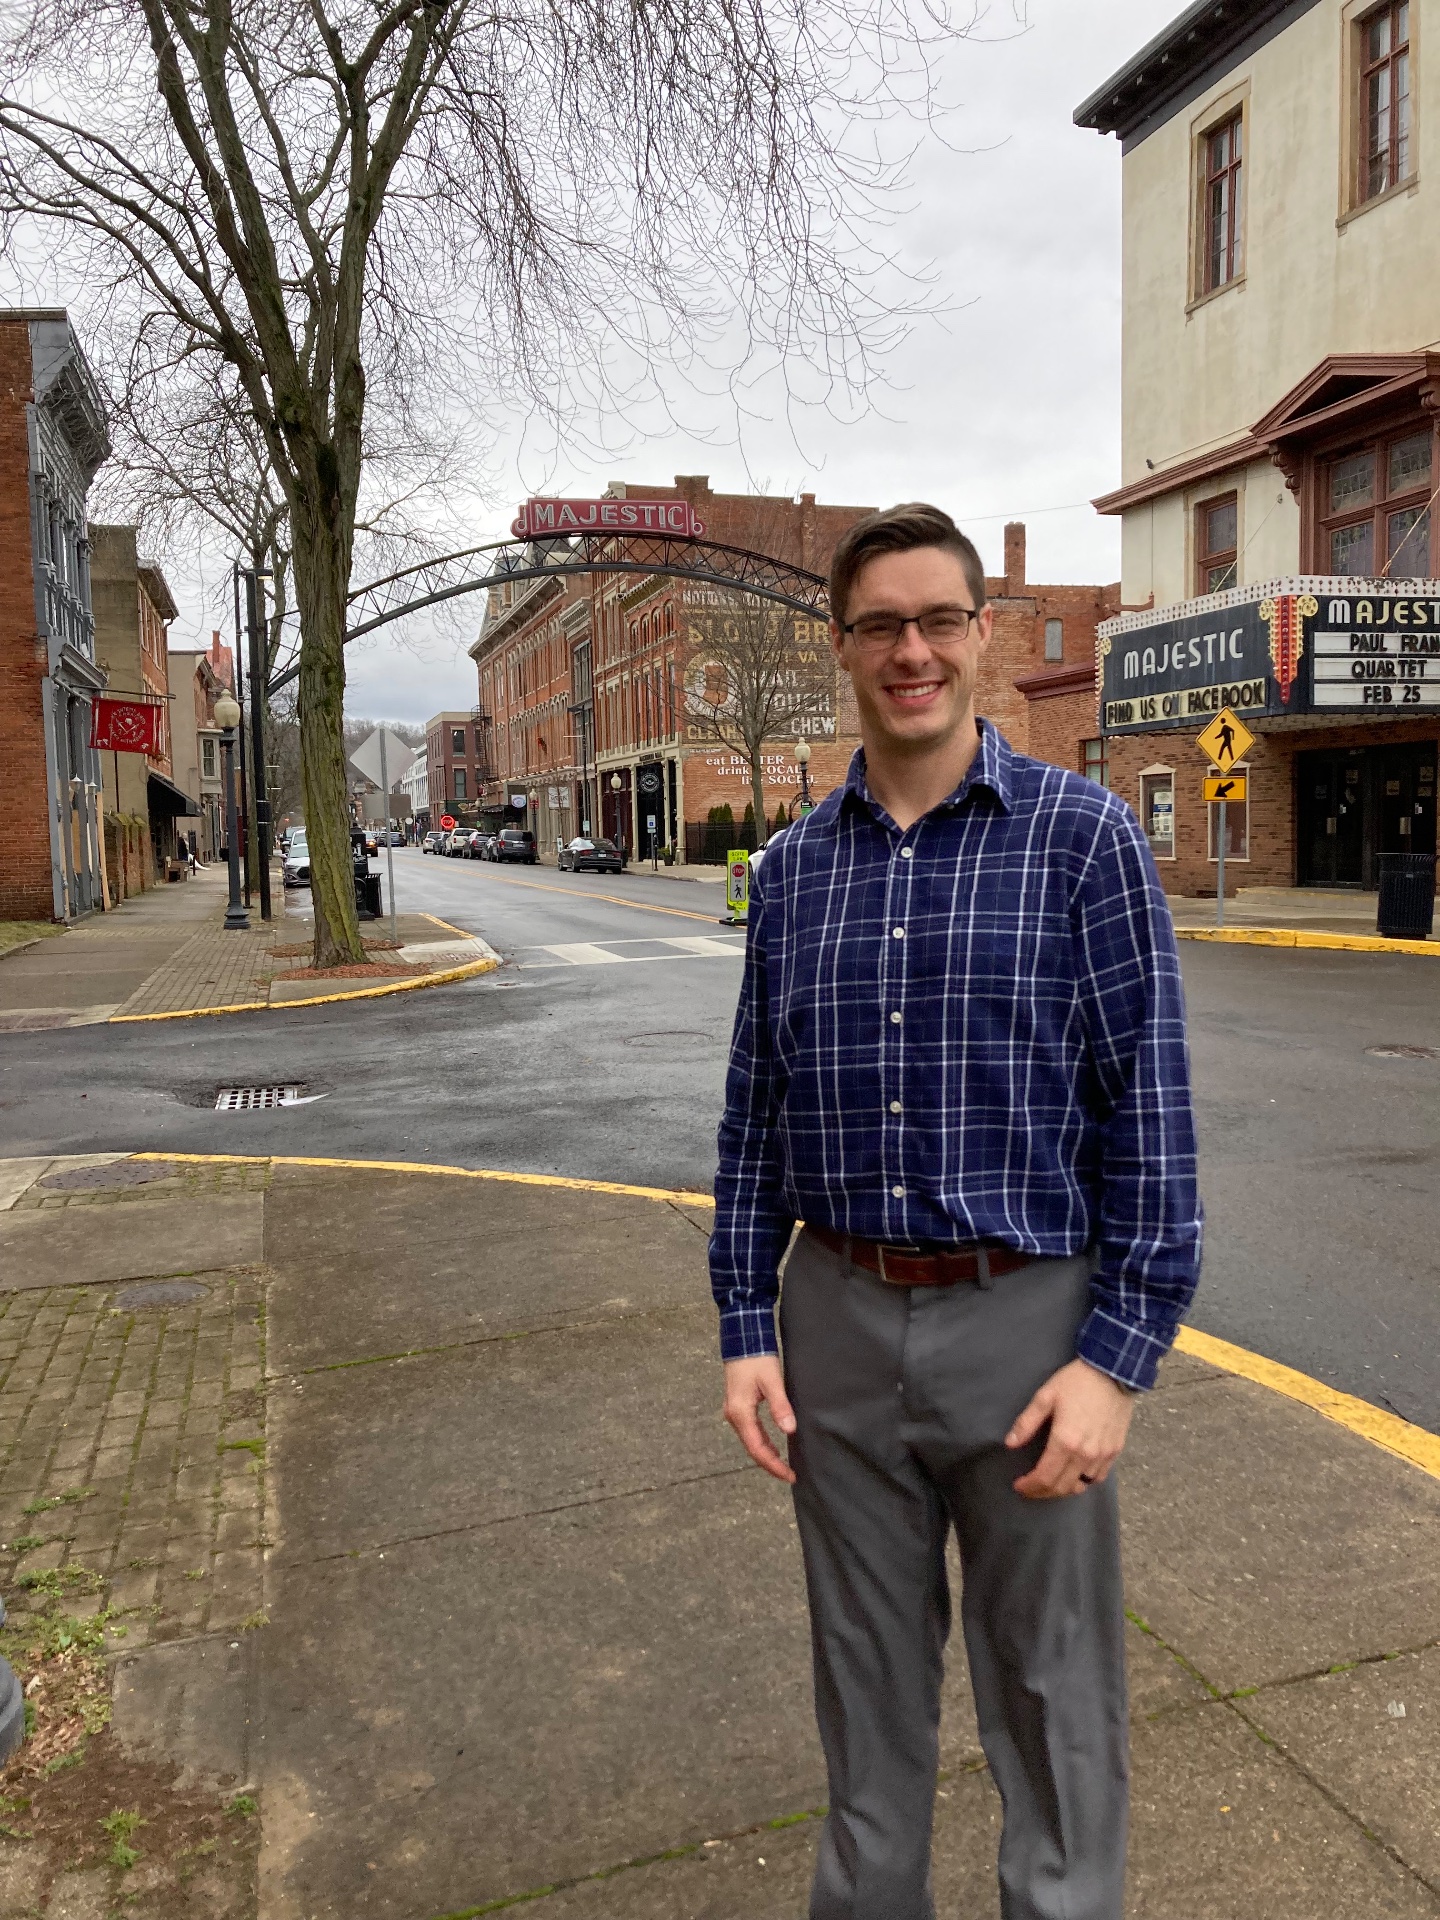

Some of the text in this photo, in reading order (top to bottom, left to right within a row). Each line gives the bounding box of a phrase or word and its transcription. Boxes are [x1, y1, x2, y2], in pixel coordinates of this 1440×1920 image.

[534, 503, 684, 530] MAJESTIC
[1350, 633, 1440, 652] PAUL FRAN
[1123, 628, 1244, 680] MAJESTIC
[1351, 659, 1428, 678] QUARTET
[1107, 701, 1133, 725] FIND
[1140, 697, 1156, 720] US
[1187, 680, 1264, 714] FACEBOOK
[1363, 685, 1421, 703] FEB 25
[791, 716, 836, 735] CHEW
[706, 756, 726, 766] eat
[717, 766, 750, 775] drink
[741, 776, 764, 785] li
